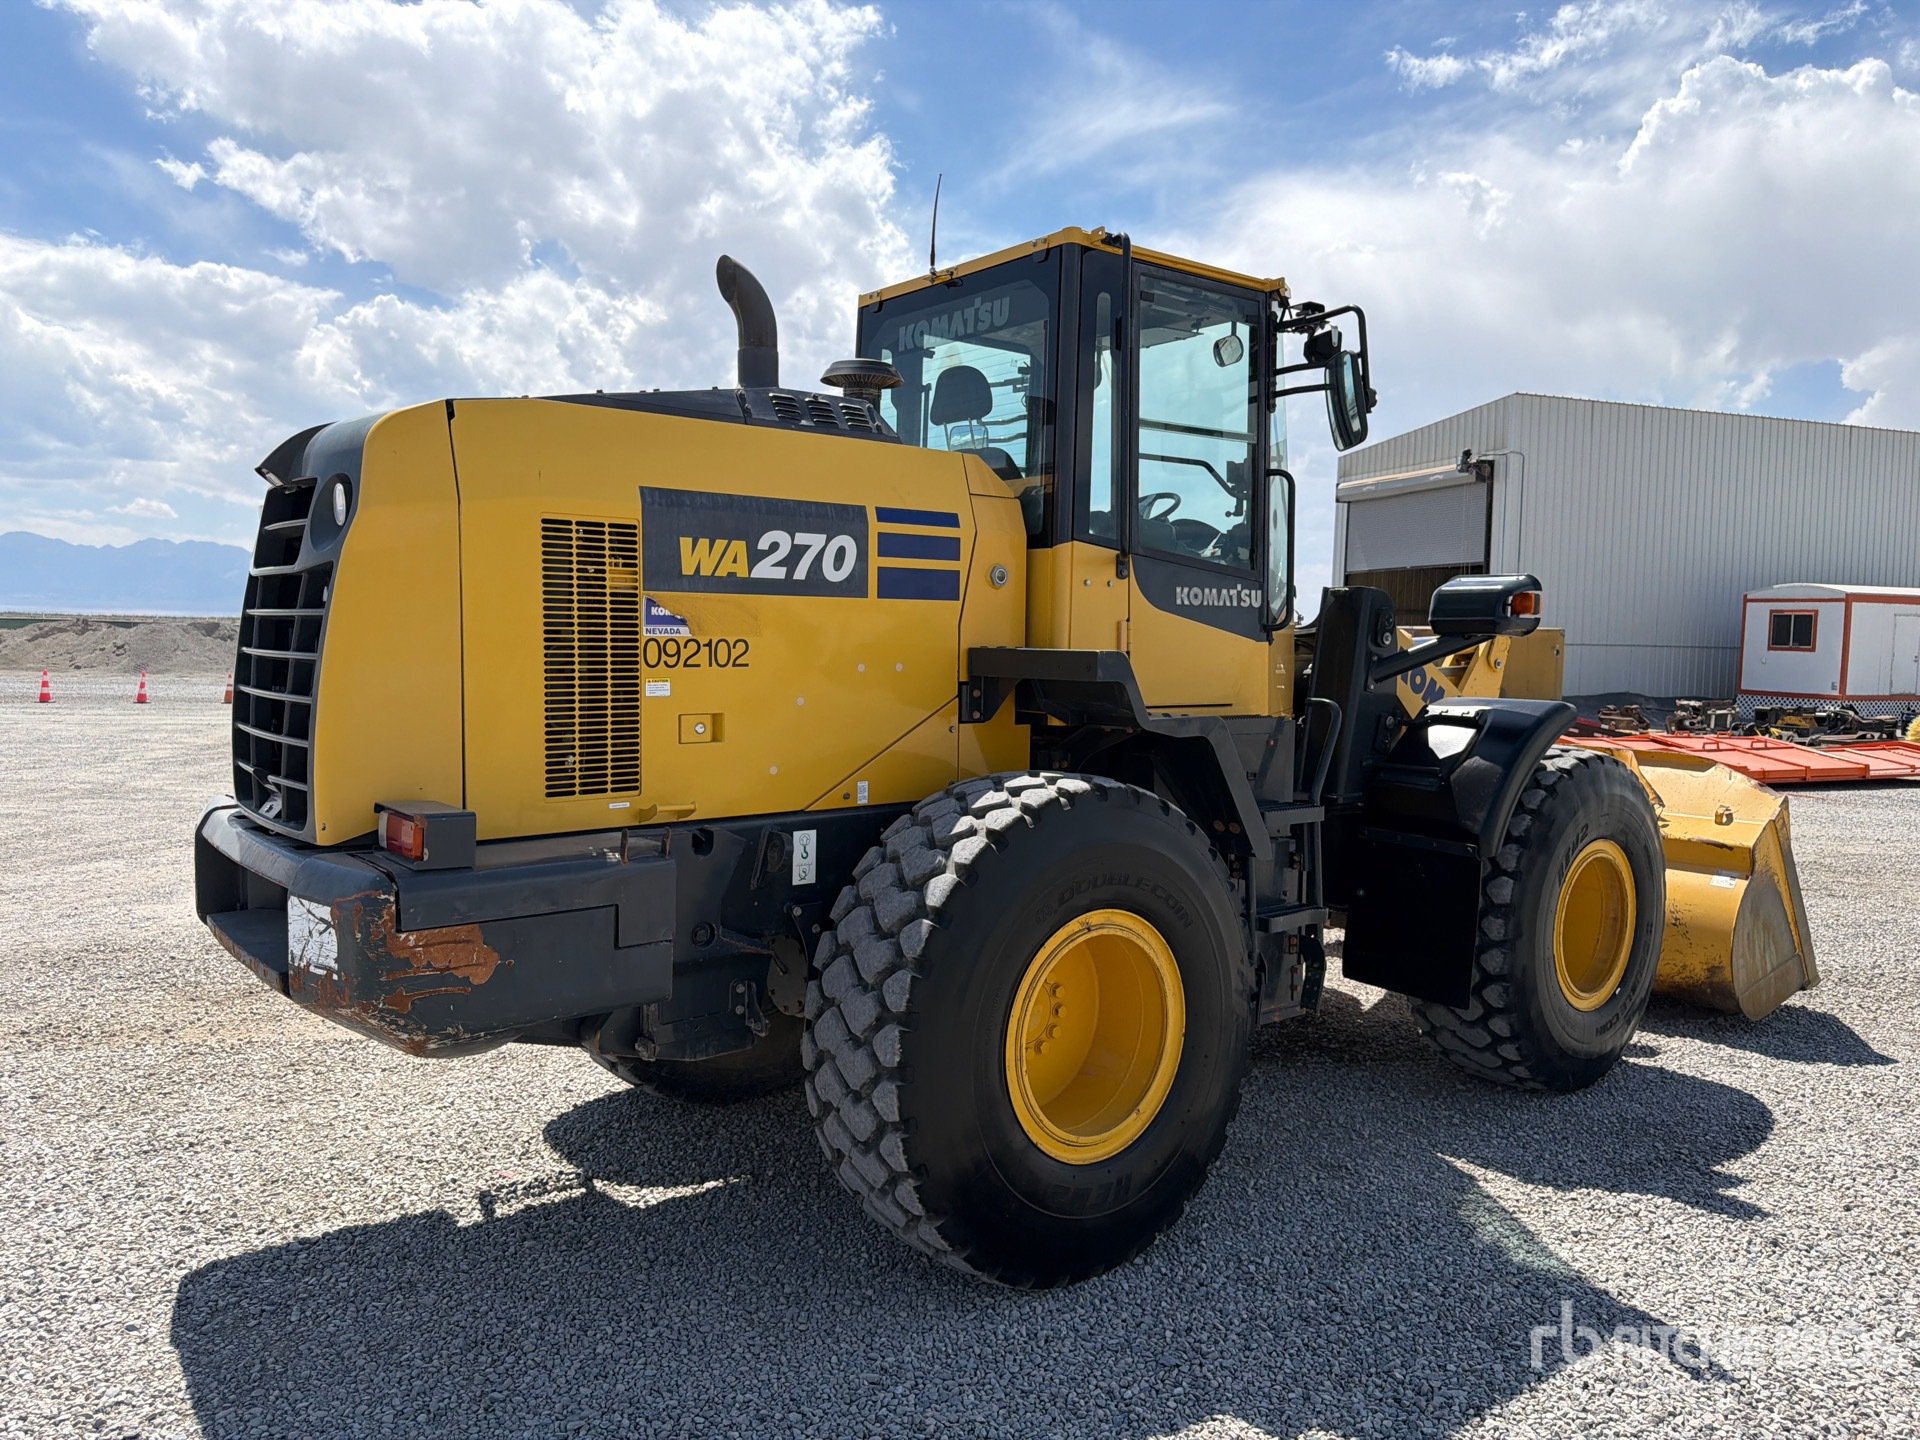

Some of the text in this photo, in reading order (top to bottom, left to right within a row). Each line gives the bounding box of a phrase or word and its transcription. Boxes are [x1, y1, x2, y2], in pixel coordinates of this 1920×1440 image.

[898, 297, 1010, 352] KOMATSU
[679, 530, 858, 583] WA270
[1175, 583, 1262, 608] KOMATSU
[645, 627, 681, 635] NEVADA
[643, 638, 750, 669] 092102
